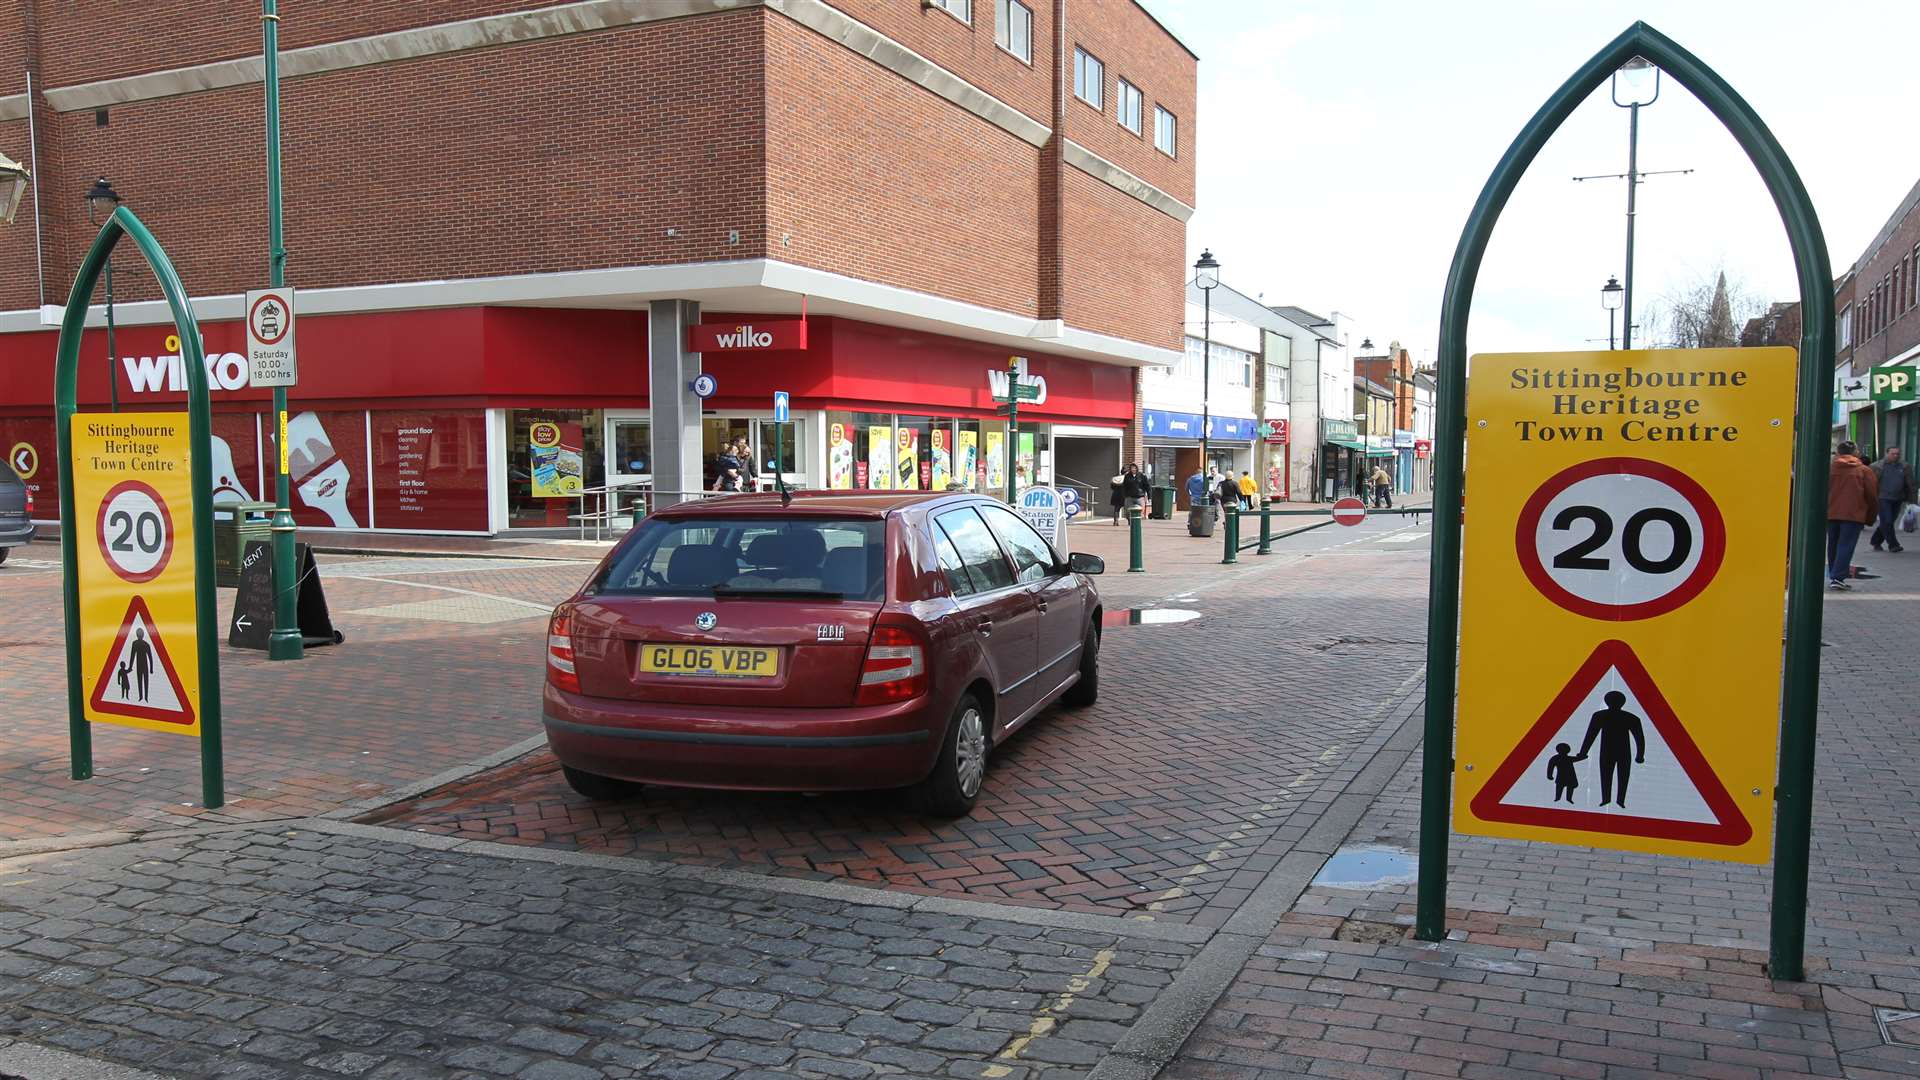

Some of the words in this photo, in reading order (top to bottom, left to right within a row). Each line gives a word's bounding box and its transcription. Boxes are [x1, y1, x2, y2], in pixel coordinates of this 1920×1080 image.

[716, 325, 772, 348] wilko
[253, 350, 289, 360] Saturday
[257, 360, 281, 369] 10.00
[253, 370, 276, 379] 18.00
[278, 370, 291, 378] hrs
[1511, 367, 1748, 394] Sittingbourne
[1552, 394, 1700, 419] Heritage
[88, 423, 175, 440] Sittingbourne
[398, 427, 418, 436] ground
[1515, 420, 1603, 442] Town
[1620, 420, 1739, 442] Centre
[105, 440, 159, 457] Heritage
[91, 456, 126, 470] Town
[131, 456, 174, 471] Centre
[1024, 492, 1053, 507] OPEN
[1021, 510, 1054, 518] Station
[110, 510, 162, 553] 20
[1030, 518, 1055, 528] AFE
[1552, 505, 1692, 574] 20
[243, 545, 264, 569] KENT
[817, 624, 845, 638] FABIA
[653, 648, 713, 669] GL06
[721, 650, 767, 671] VBP
